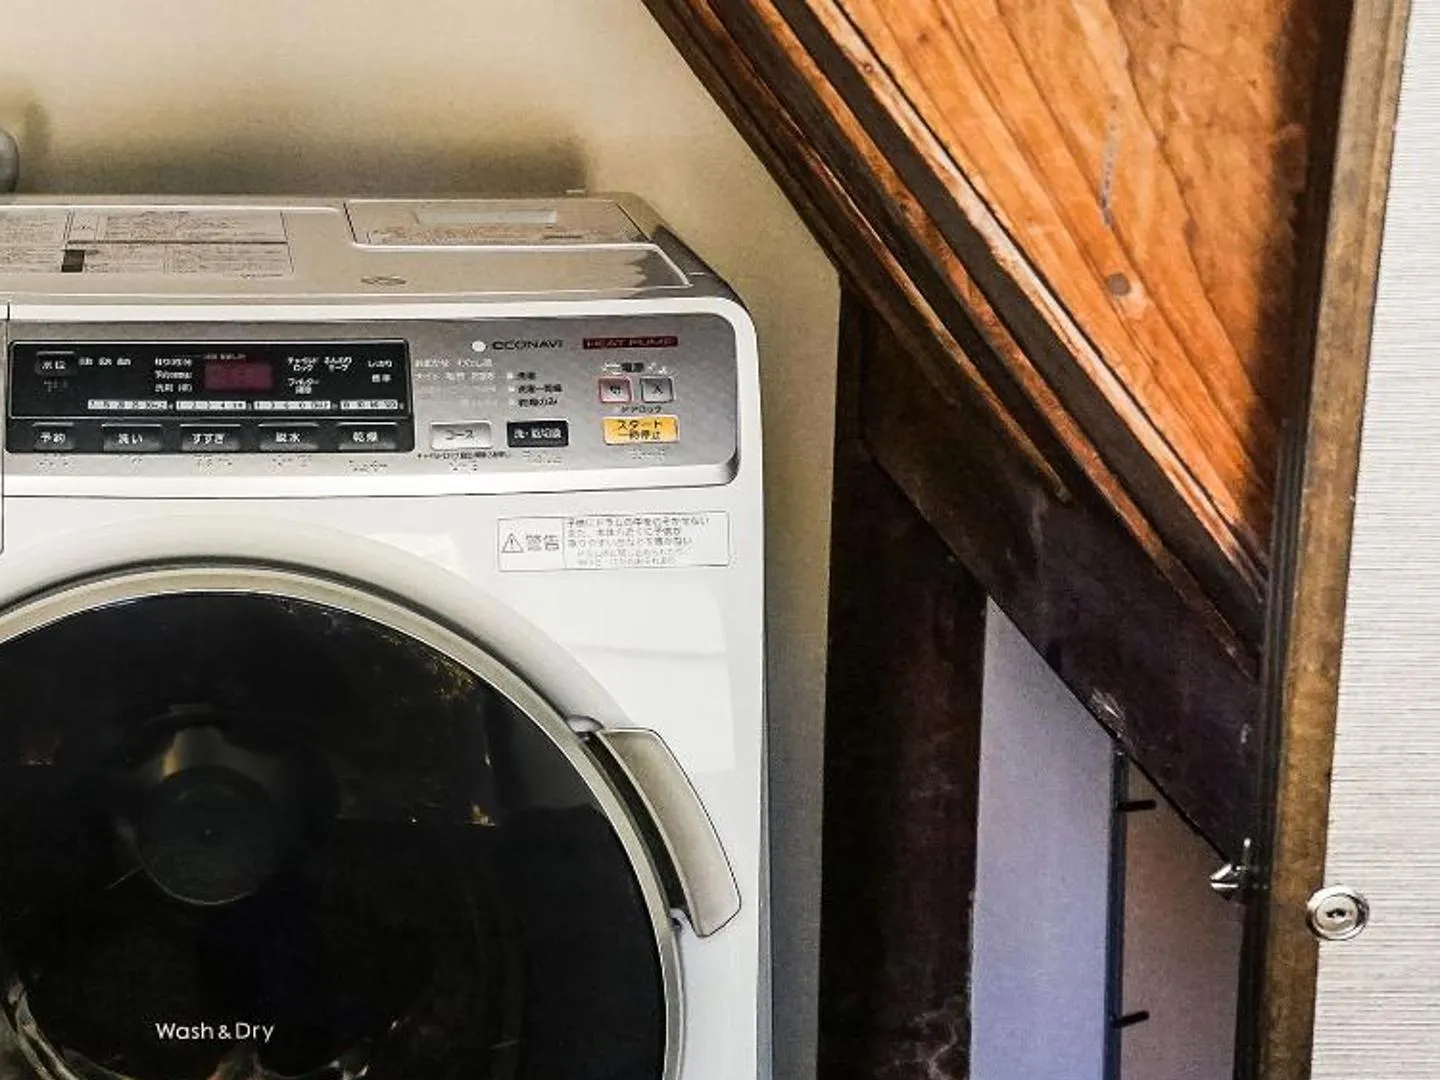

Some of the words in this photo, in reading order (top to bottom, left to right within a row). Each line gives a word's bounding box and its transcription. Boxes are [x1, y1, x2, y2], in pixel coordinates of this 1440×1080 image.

[617, 420, 664, 432] スタート
[191, 433, 226, 445] すすぎ
